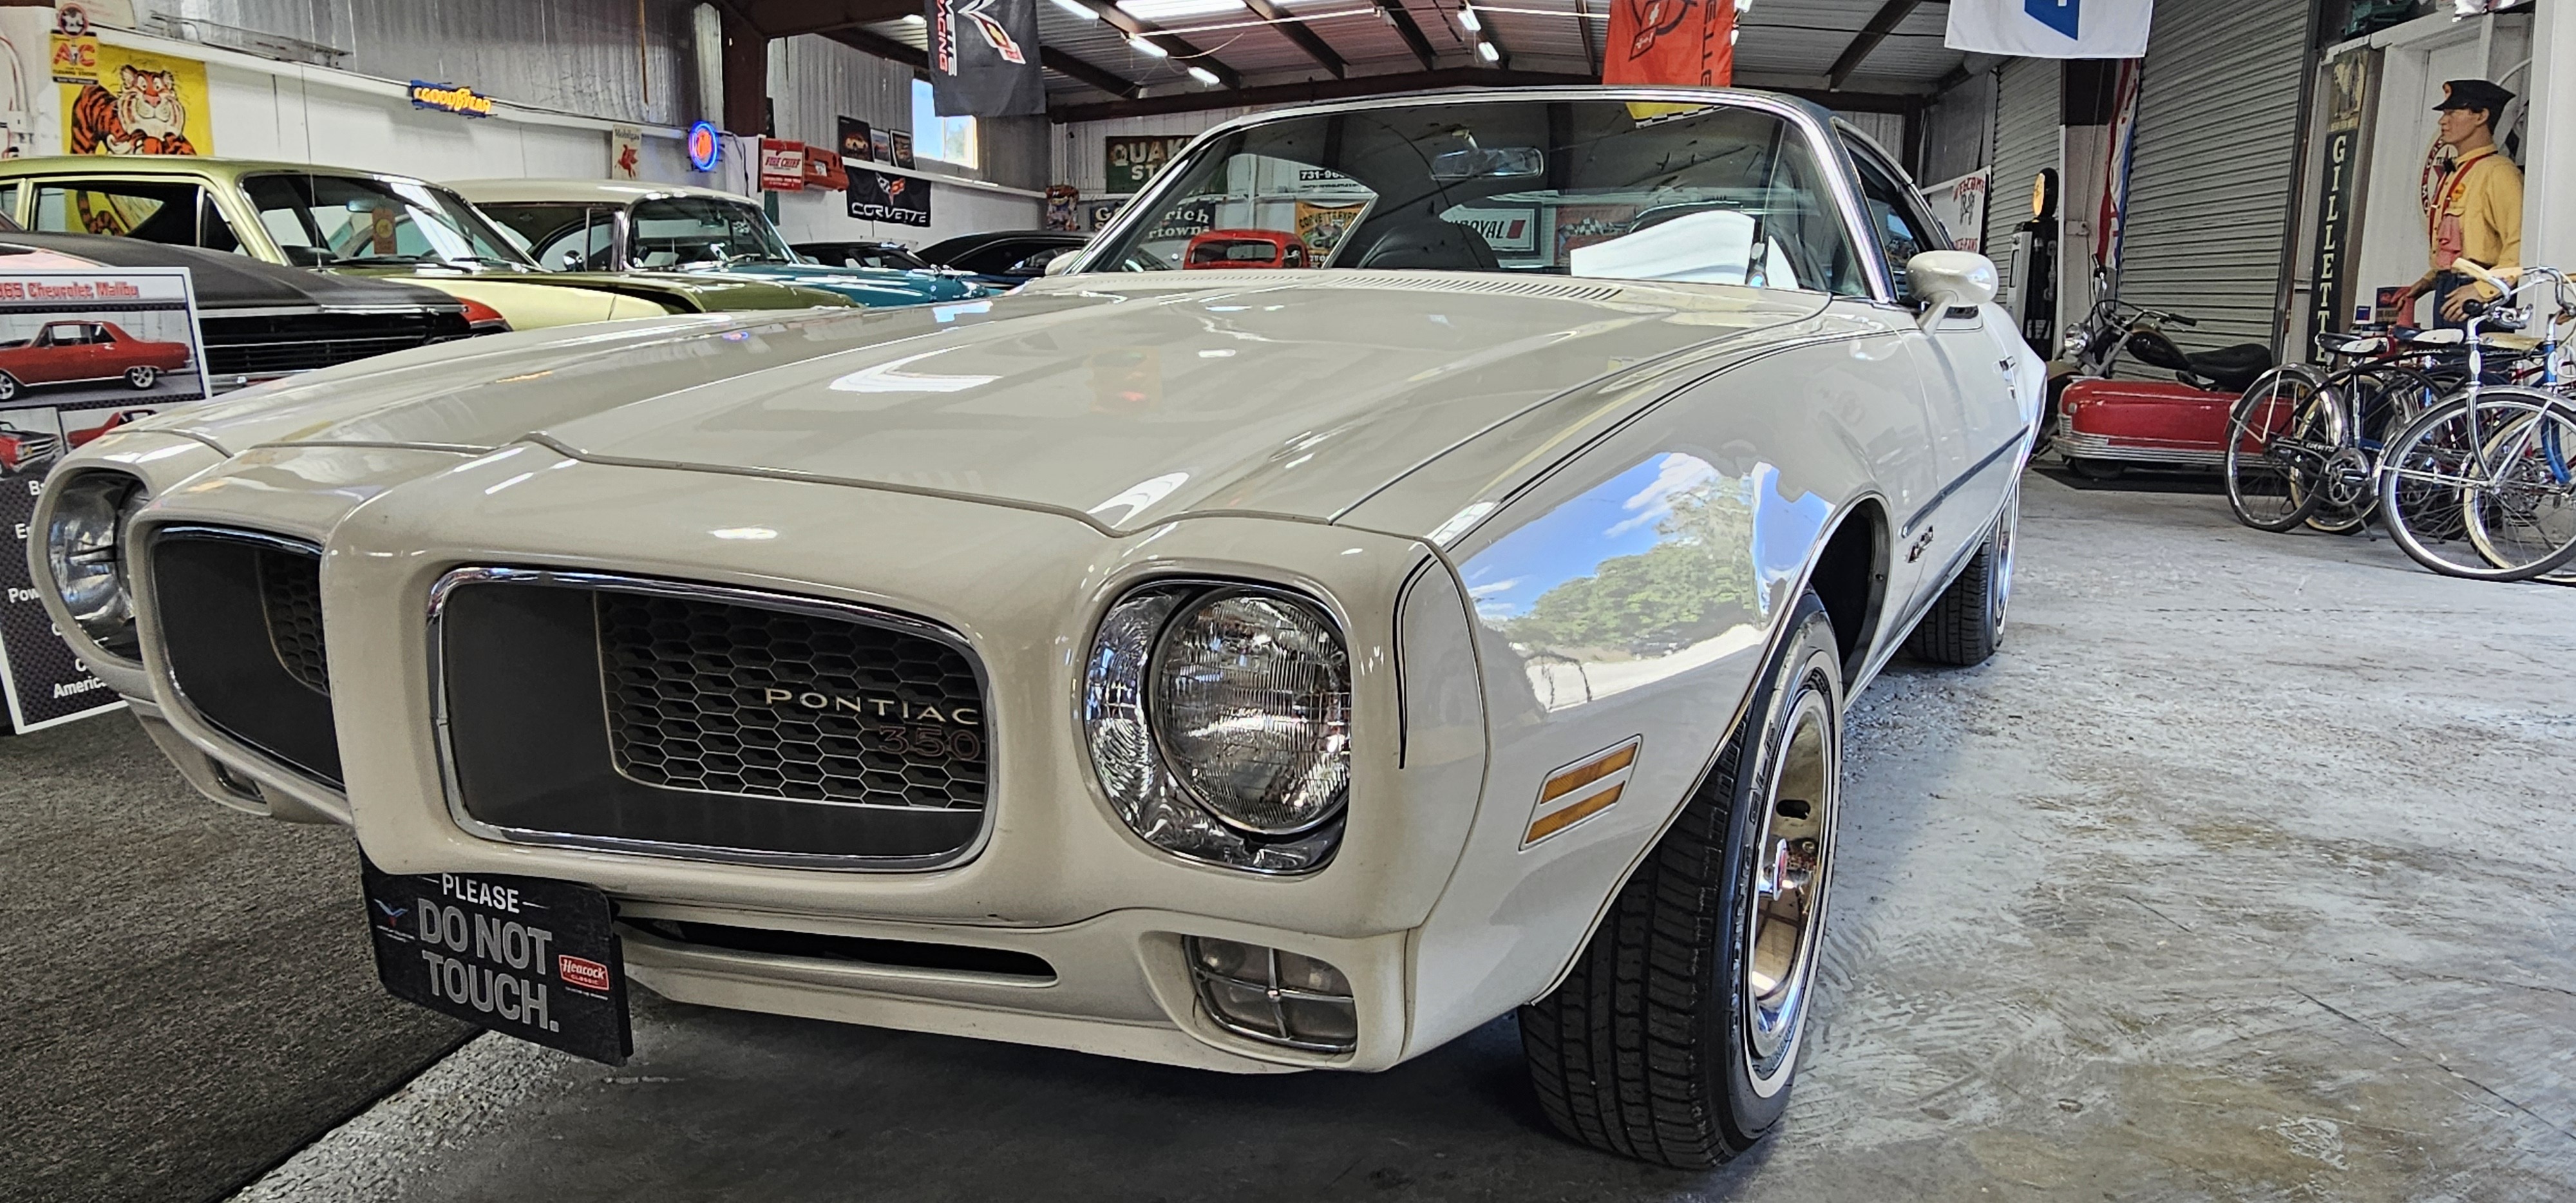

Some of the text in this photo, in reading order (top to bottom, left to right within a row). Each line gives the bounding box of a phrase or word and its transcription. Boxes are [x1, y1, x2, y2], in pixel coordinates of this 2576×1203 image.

[936, 0, 947, 71] ACING
[945, 0, 958, 76] VETTE
[1112, 137, 1191, 166] QUAK
[1953, 176, 1984, 202] WELCOME
[851, 202, 927, 223] CORVETTE
[28, 281, 94, 298] Chevrolet
[95, 281, 140, 298] Malibu
[764, 687, 979, 725] PONTIAC
[878, 725, 981, 761] 350
[442, 873, 520, 913] PLEASE
[417, 898, 553, 975] DO NOT
[562, 959, 605, 980] Heacock
[571, 974, 599, 985] CLASSIC
[421, 950, 560, 1032] TOUCH.
